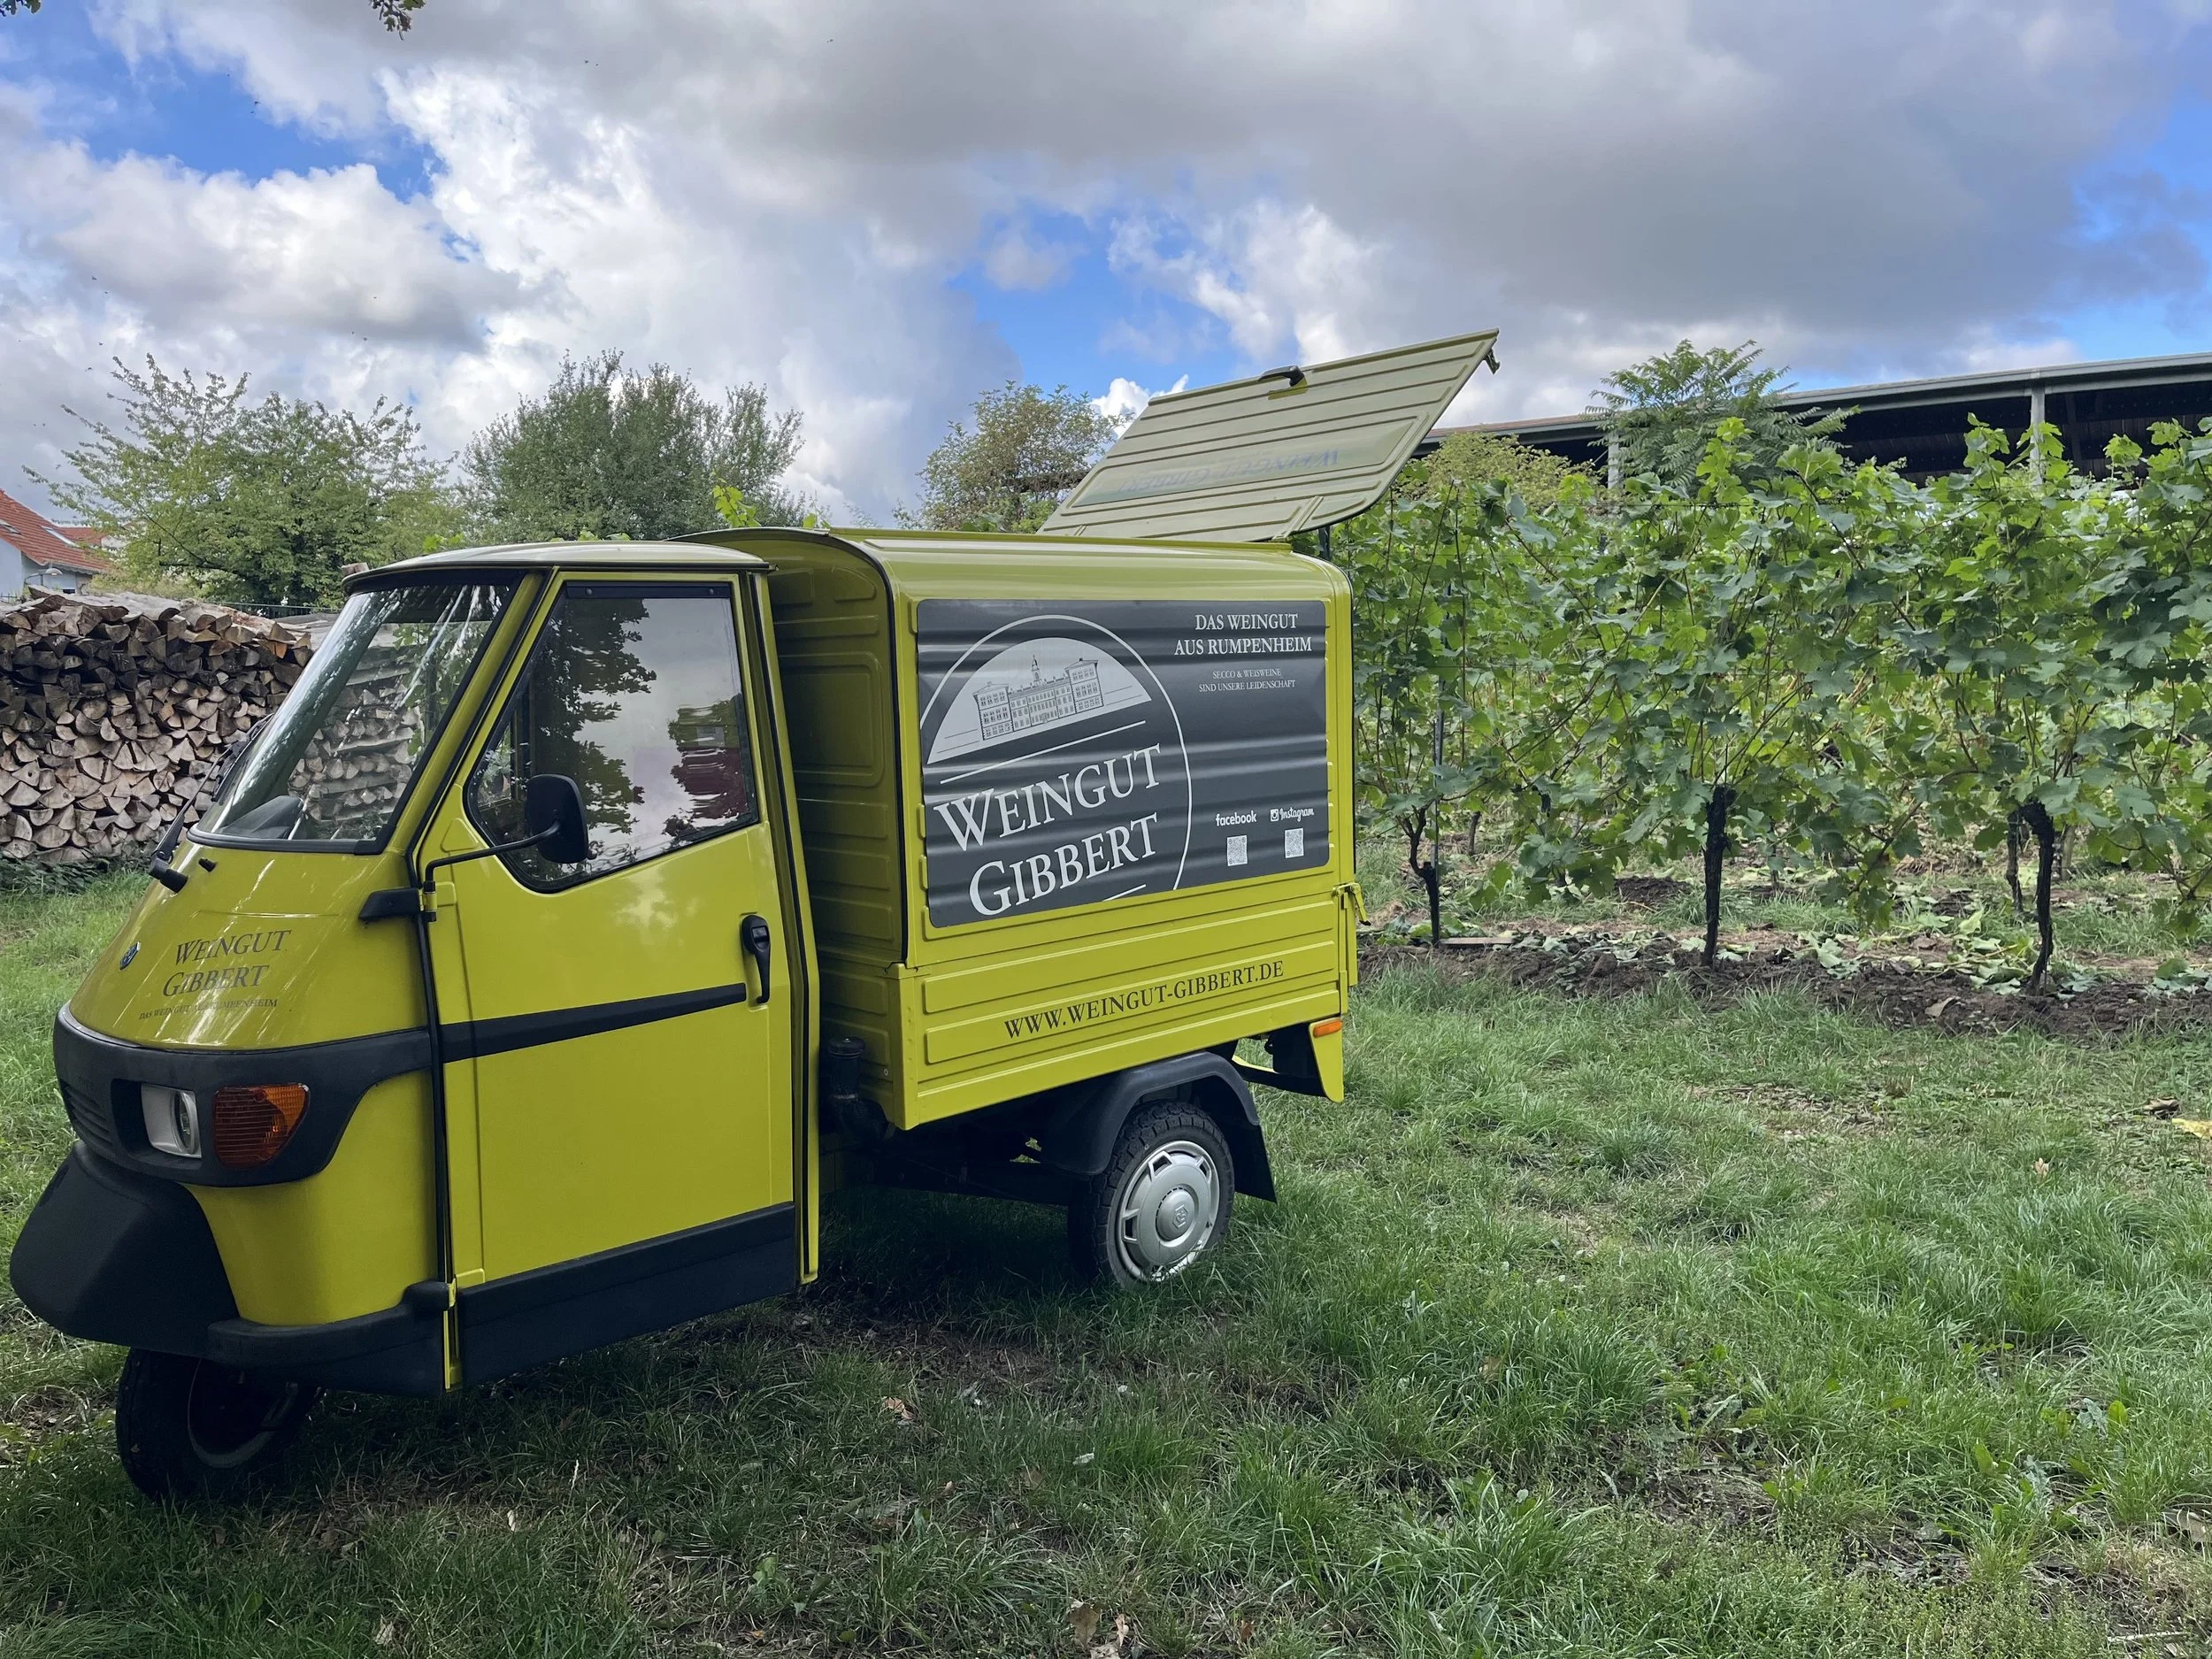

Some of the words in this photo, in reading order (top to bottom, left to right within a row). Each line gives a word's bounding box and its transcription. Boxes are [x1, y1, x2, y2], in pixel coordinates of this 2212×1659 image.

[1194, 614, 1225, 630] DAS
[1227, 613, 1298, 630] WEINGUT
[1174, 639, 1204, 656] AUS
[1208, 637, 1312, 655] RUMPENHEIM
[1199, 683, 1217, 692] SIND
[1217, 681, 1245, 691] UNSERE
[1246, 680, 1296, 689] LEIDENSCHAFT
[933, 742, 1162, 852] WEINGUT
[1215, 810, 1257, 826] facebook
[1279, 807, 1314, 822] Instagram
[969, 812, 1158, 916] GIBBERT
[175, 929, 292, 965] WEINGUT
[163, 964, 270, 997] GIBBERT
[1003, 960, 1284, 1040] WWW.WEINGUT-GIBBERT.DE
